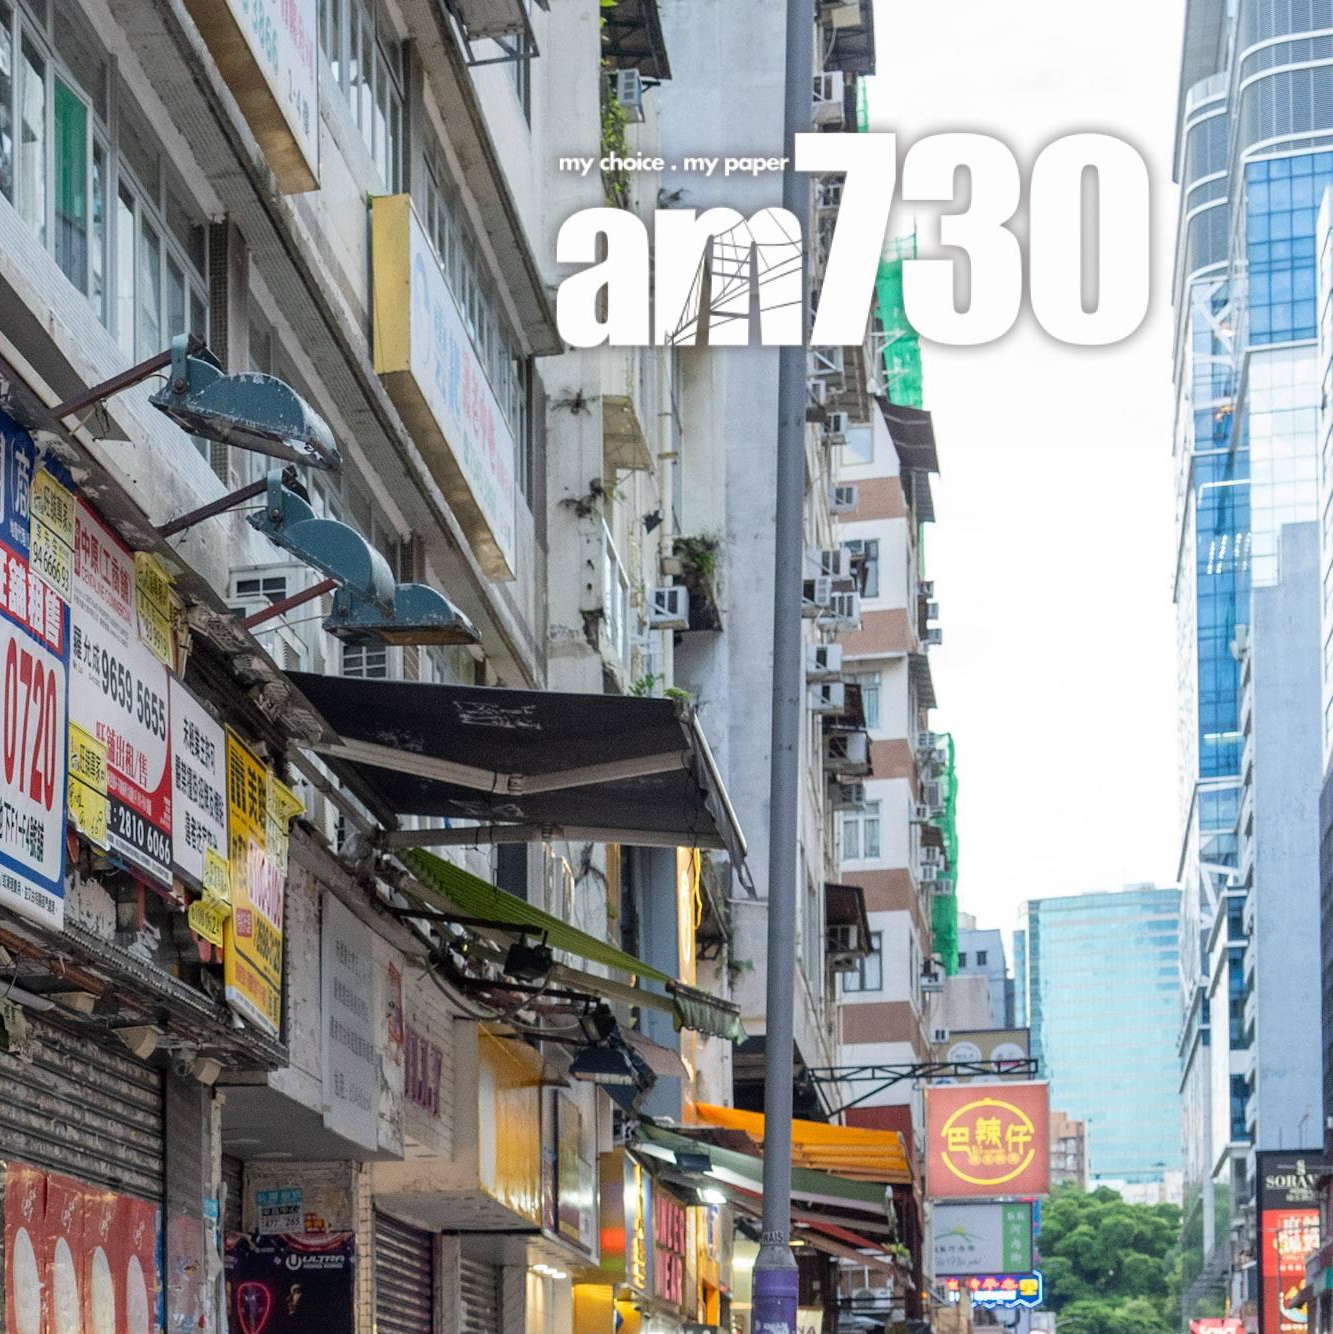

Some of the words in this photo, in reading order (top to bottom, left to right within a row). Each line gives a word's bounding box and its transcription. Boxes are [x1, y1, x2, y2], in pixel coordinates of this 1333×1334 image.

[4, 636, 57, 813] 0720
[101, 648, 134, 715] 9659
[136, 679, 167, 742] 5655
[118, 801, 145, 847] 2810
[146, 826, 171, 866] 6066
[302, 1254, 345, 1263] ULTRA
